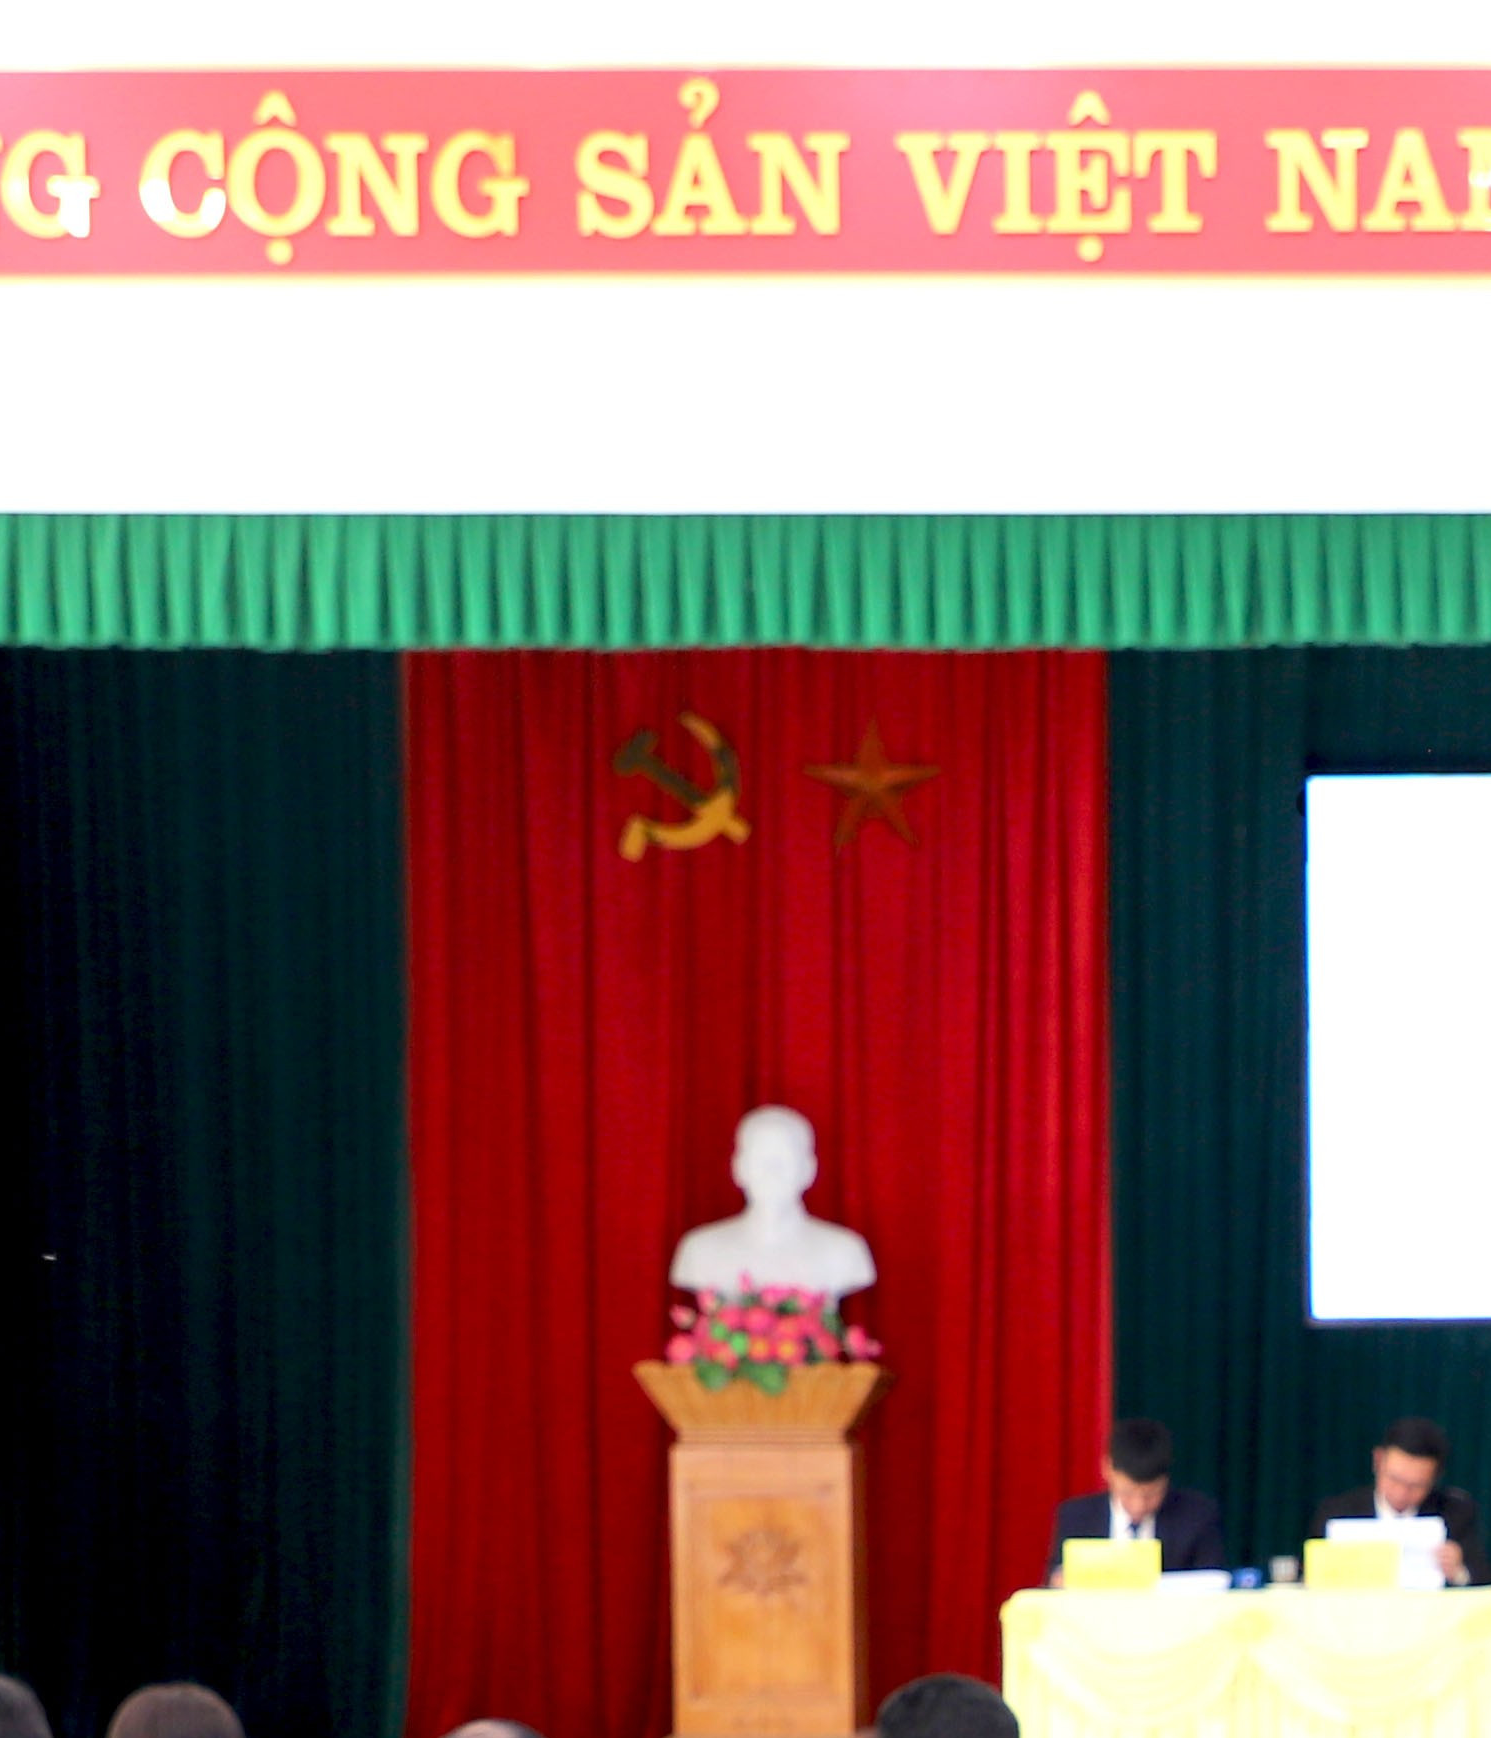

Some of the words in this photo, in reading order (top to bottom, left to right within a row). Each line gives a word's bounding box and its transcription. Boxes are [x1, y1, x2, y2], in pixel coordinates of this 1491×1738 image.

[139, 90, 529, 264] CỘNG
[576, 78, 847, 237] SẢN
[896, 90, 1216, 263] VIỆT
